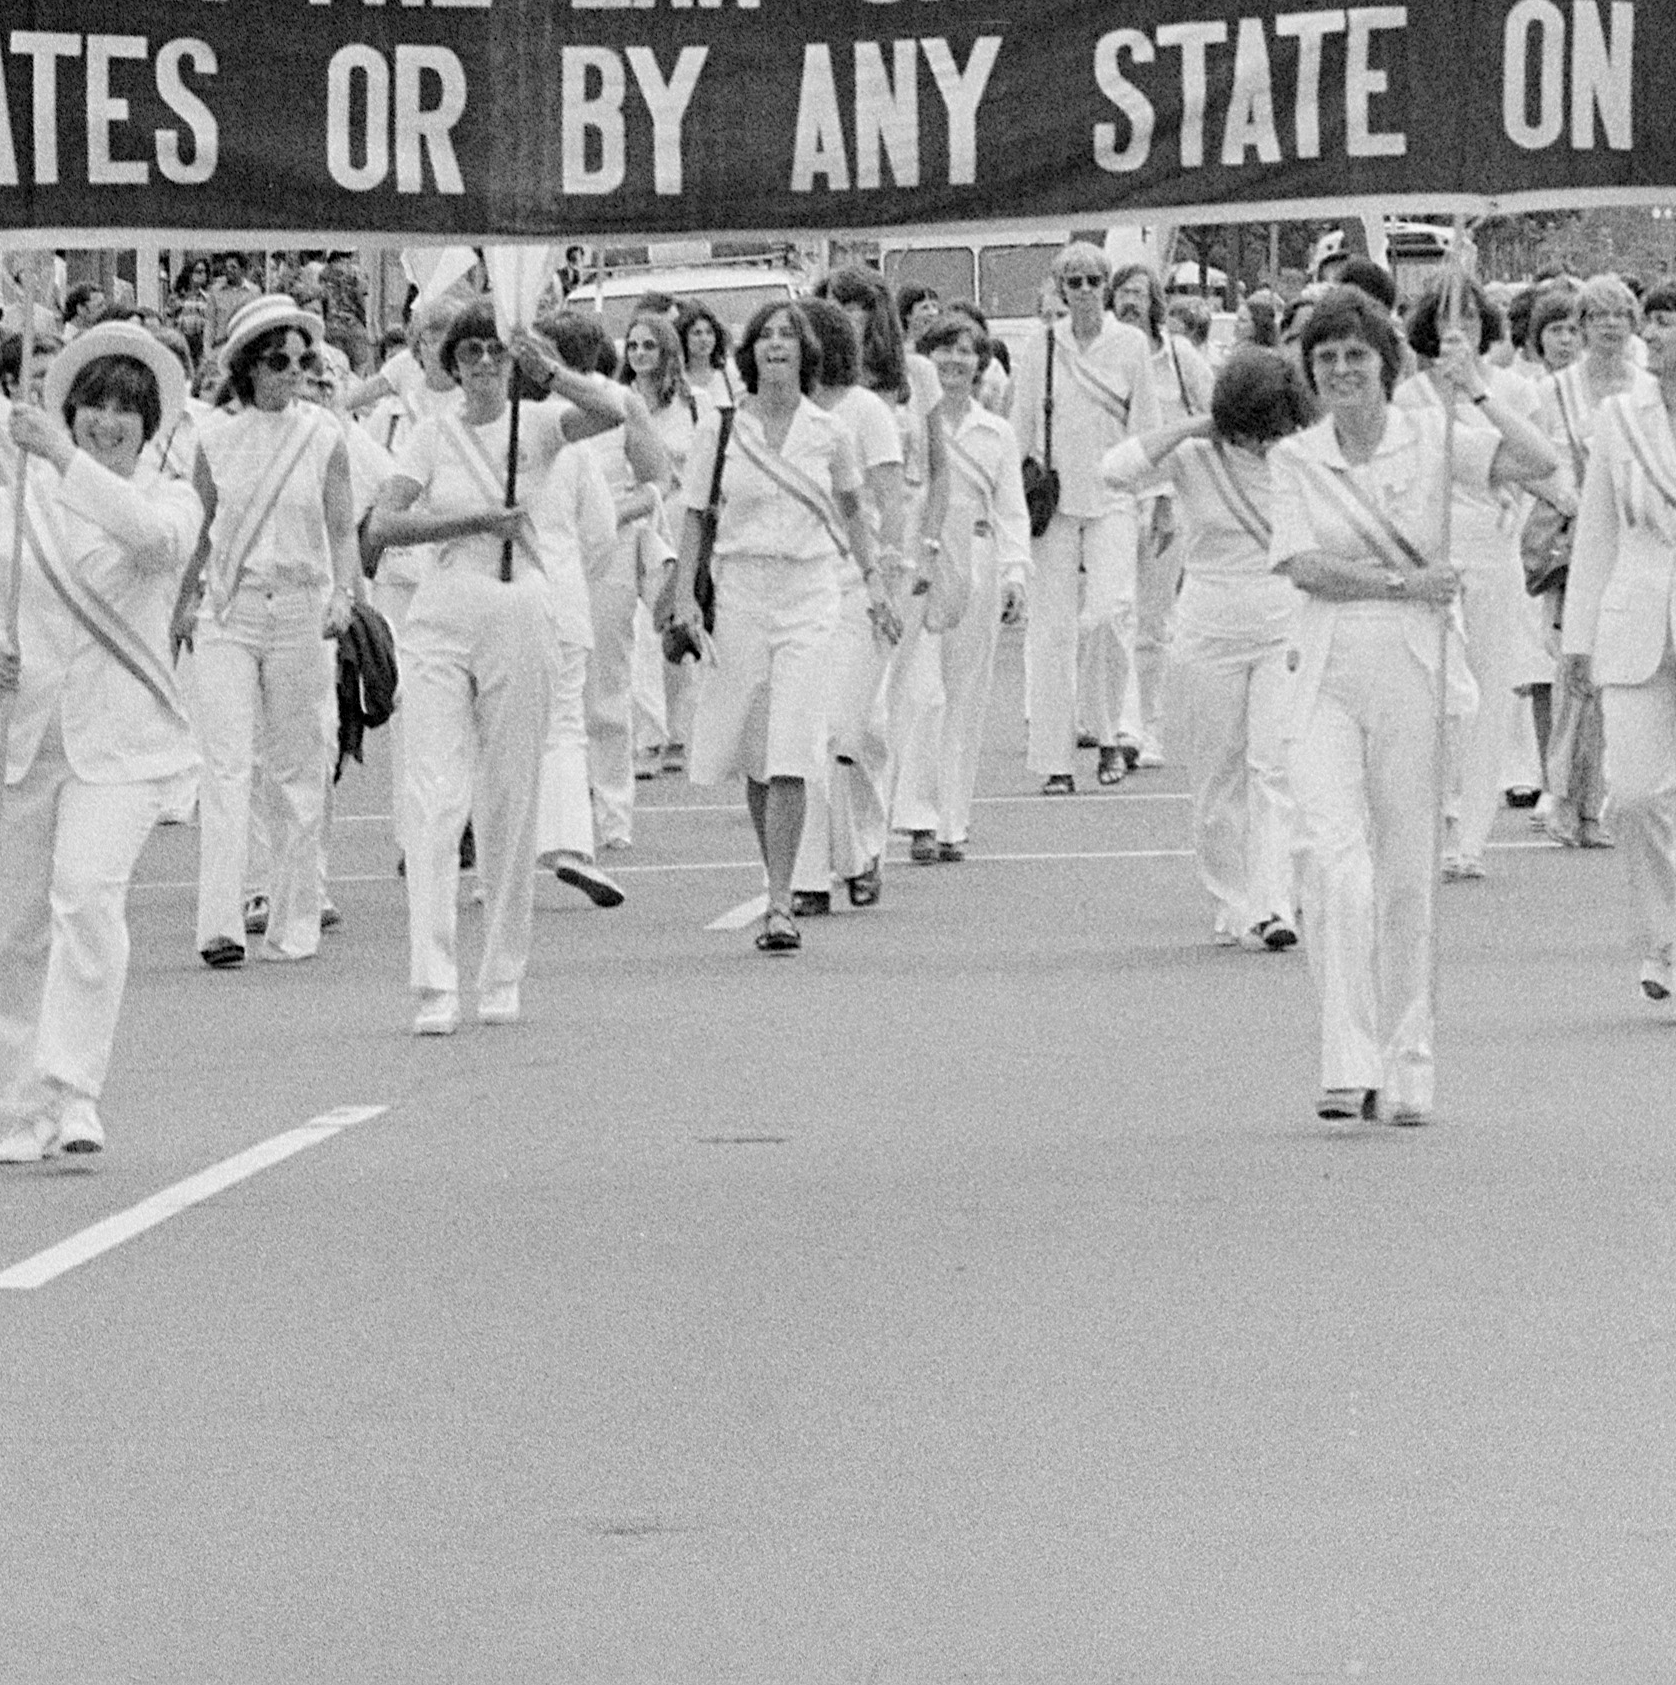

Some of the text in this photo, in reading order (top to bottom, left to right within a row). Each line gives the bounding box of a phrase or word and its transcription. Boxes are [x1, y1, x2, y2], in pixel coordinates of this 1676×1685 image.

[325, 43, 468, 195] OR
[559, 44, 710, 196] BY
[790, 35, 1003, 192] ANY
[1093, 5, 1408, 173] STATE
